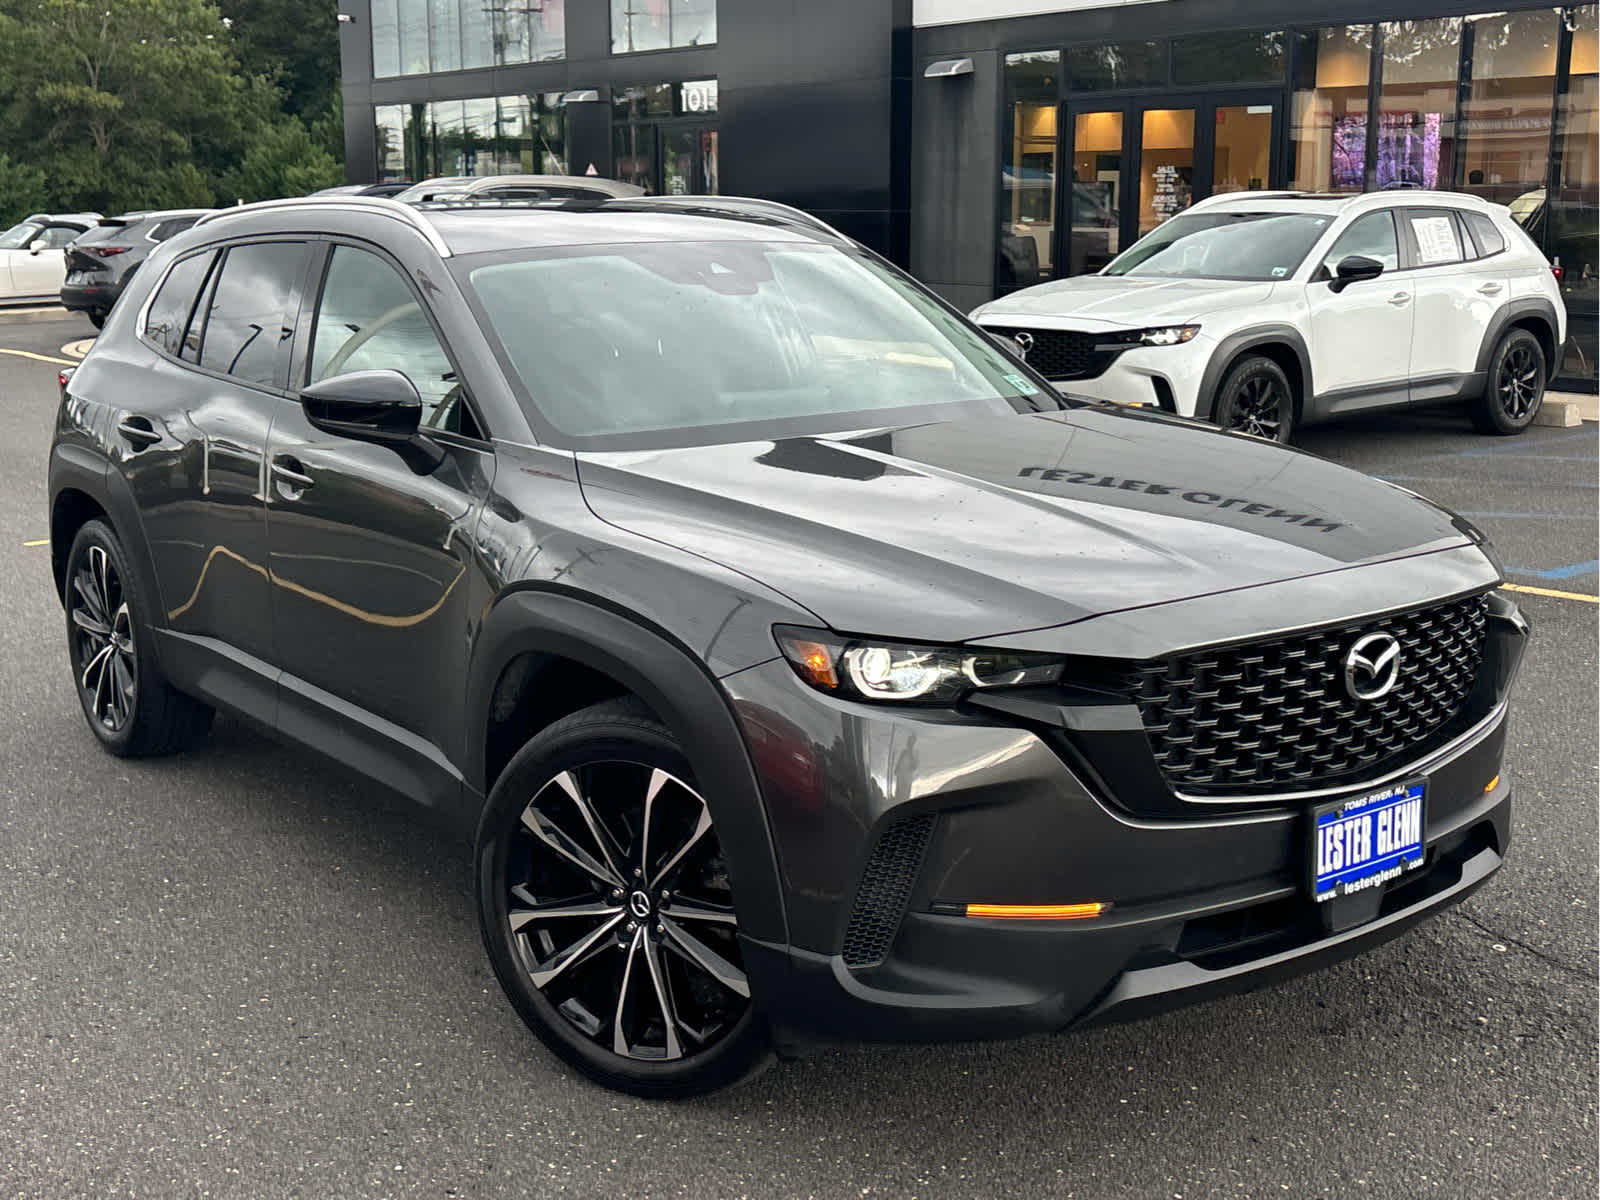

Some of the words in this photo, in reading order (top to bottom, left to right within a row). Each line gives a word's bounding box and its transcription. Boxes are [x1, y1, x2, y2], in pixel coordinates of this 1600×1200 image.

[1344, 797, 1368, 812] TOMS
[1394, 785, 1405, 797] NJ
[1317, 815, 1372, 876] LESTER
[1377, 799, 1421, 855] GLENN
[1344, 865, 1402, 895] lesterglenn
